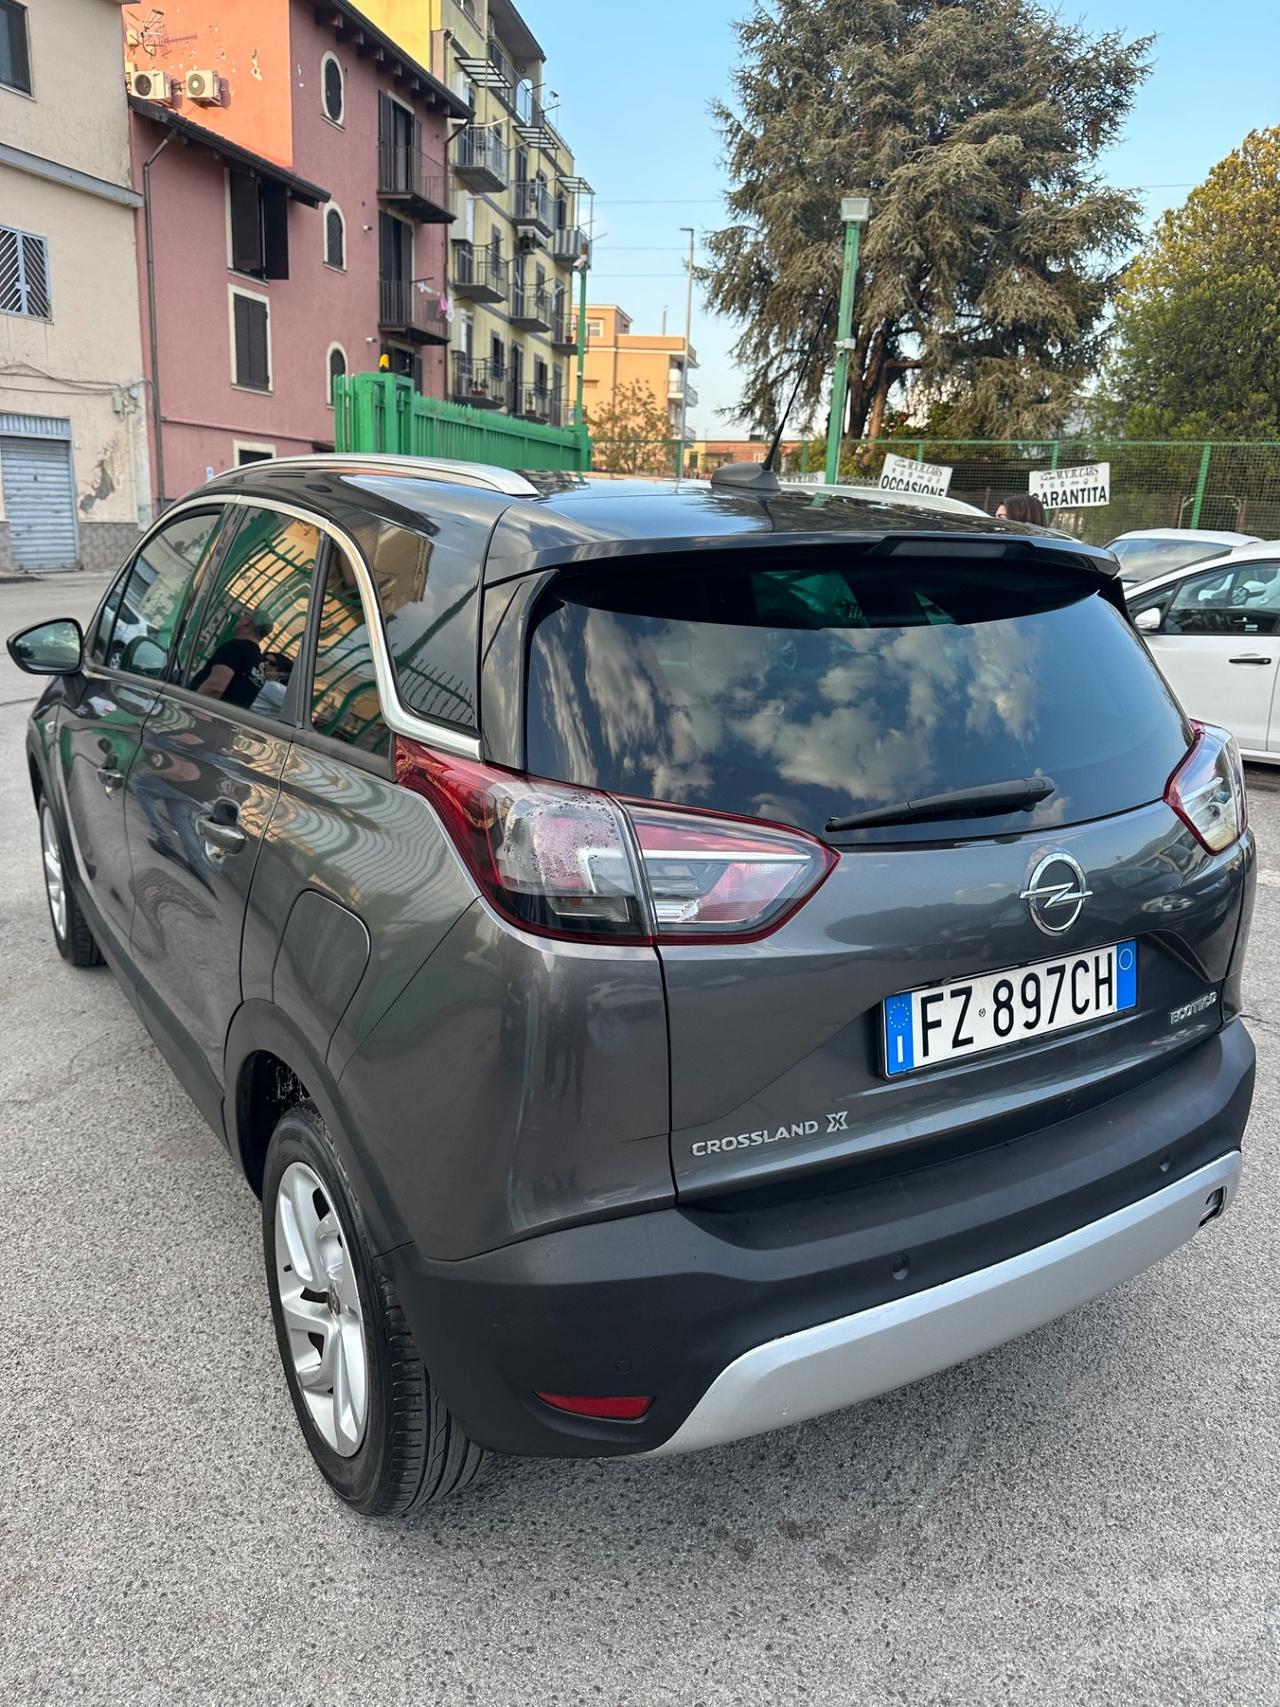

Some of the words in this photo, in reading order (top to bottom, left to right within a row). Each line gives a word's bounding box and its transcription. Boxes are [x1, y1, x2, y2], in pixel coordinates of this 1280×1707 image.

[921, 986, 974, 1057] FZ
[992, 952, 1113, 1037] 897CH
[692, 1120, 819, 1157] CROSSLAND
[826, 1110, 849, 1133] X
